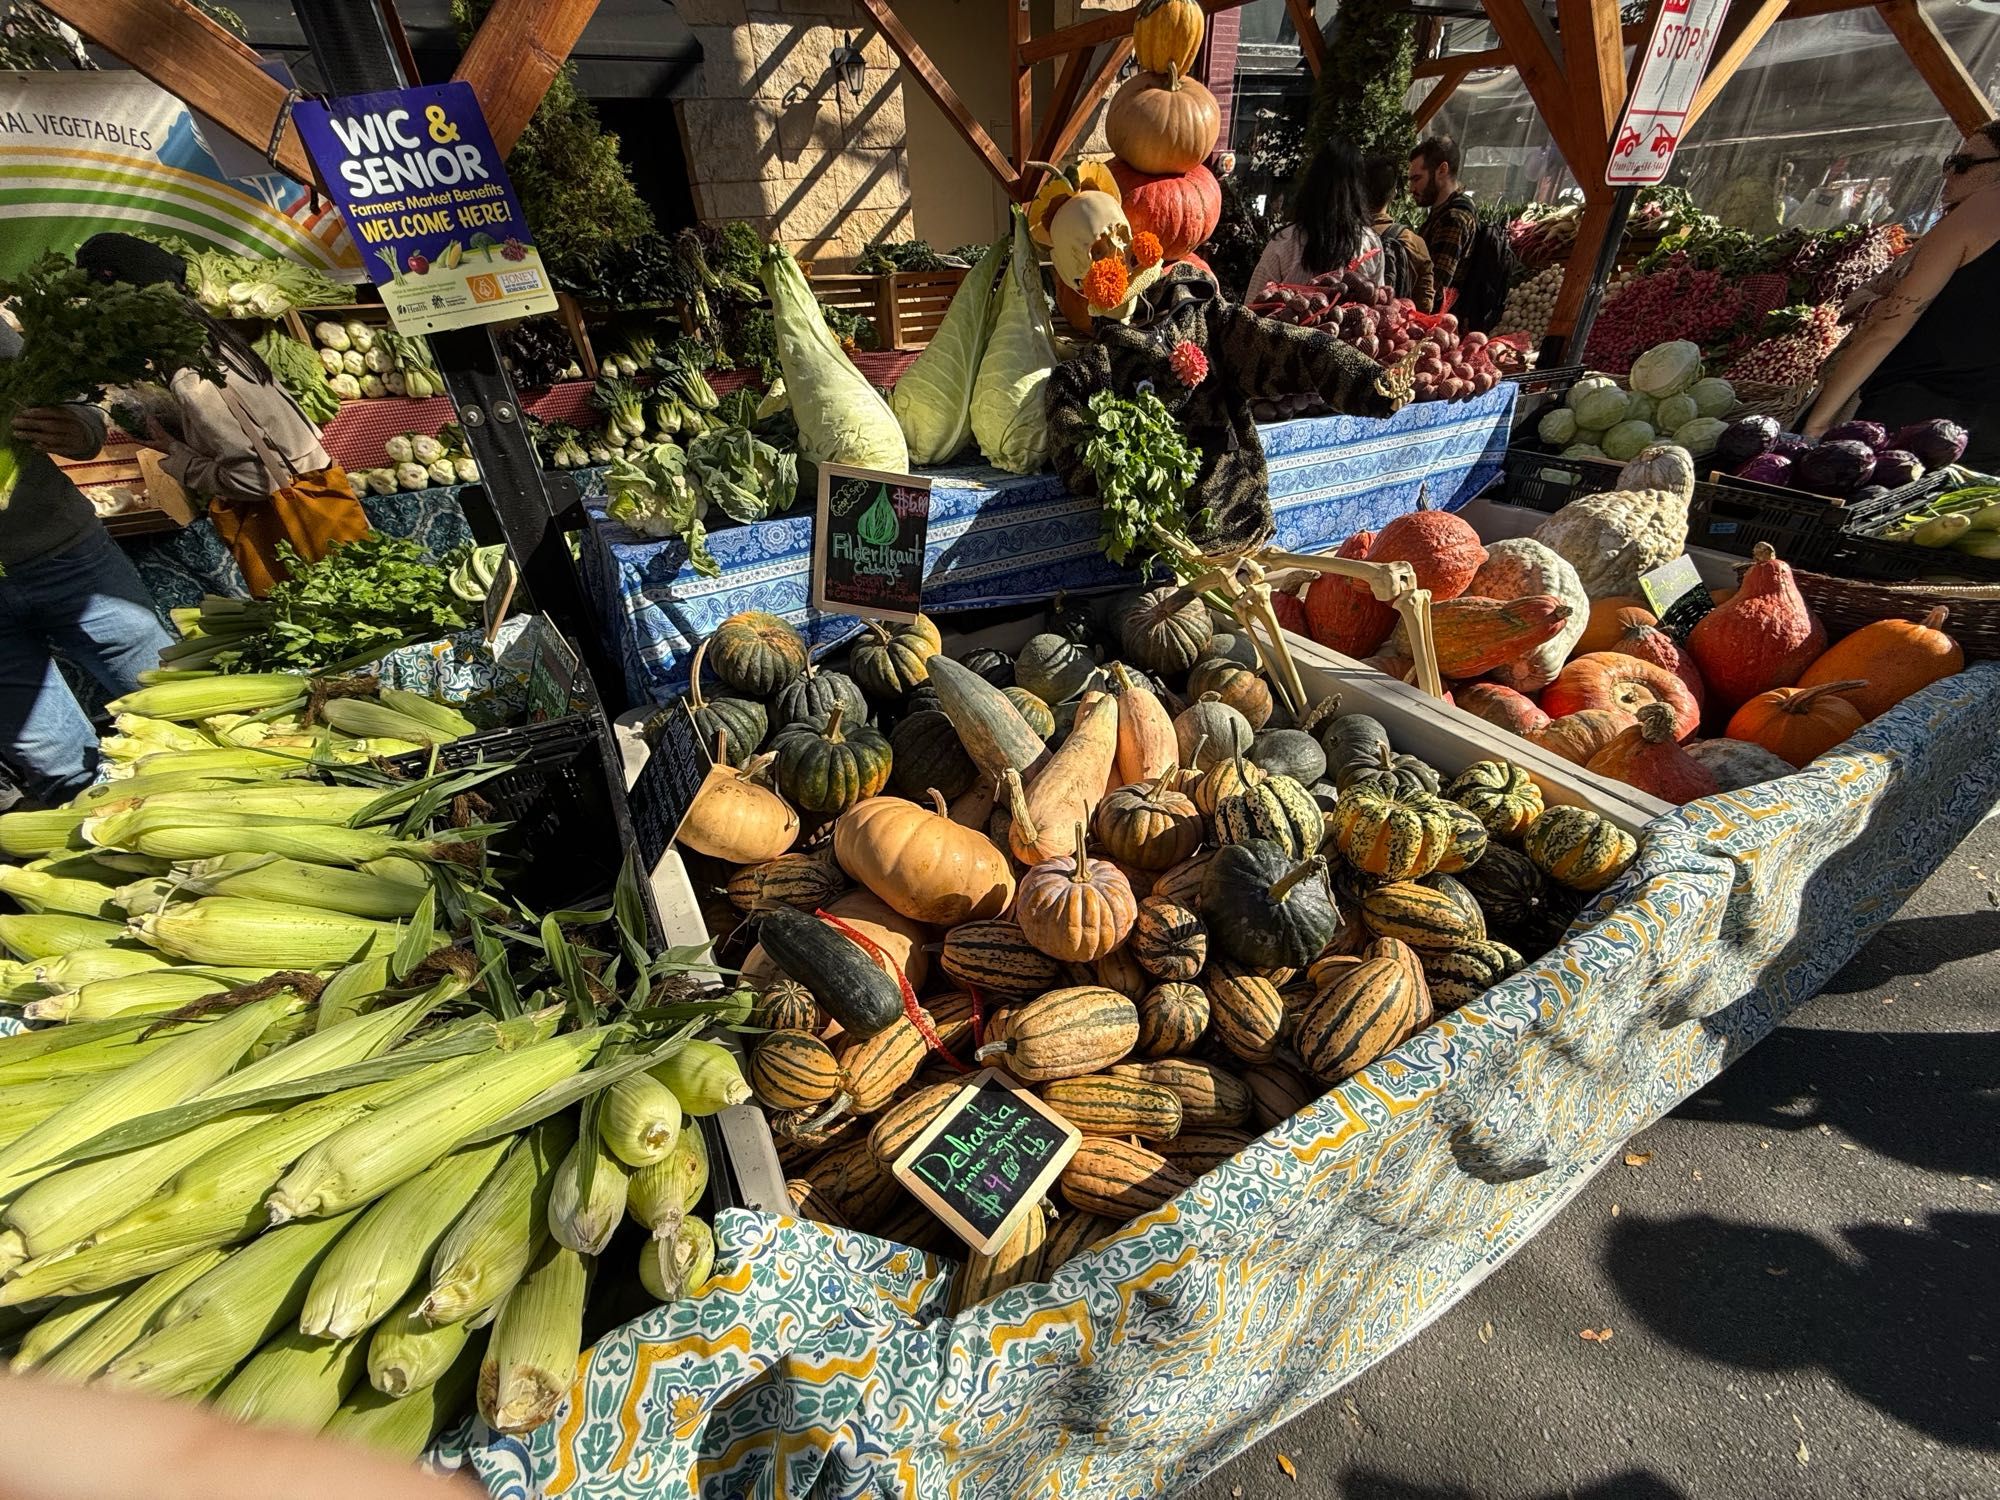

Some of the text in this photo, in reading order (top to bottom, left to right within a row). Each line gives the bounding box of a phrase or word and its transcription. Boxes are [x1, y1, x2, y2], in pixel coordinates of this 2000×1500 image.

[33, 113, 153, 150] VEGETABLES
[330, 105, 461, 156] WIC &
[340, 144, 489, 198] SENIOR
[349, 183, 505, 217] Farmers Market Benefits
[357, 200, 513, 244] WELCOME HERE!
[500, 271, 535, 285] HONEY
[407, 303, 428, 314] Health
[854, 561, 904, 586] Cabbage
[912, 1104, 1018, 1192] Delicata
[1555, 1185, 1572, 1201] JOANN
[1442, 1285, 1462, 1305] JOANN
